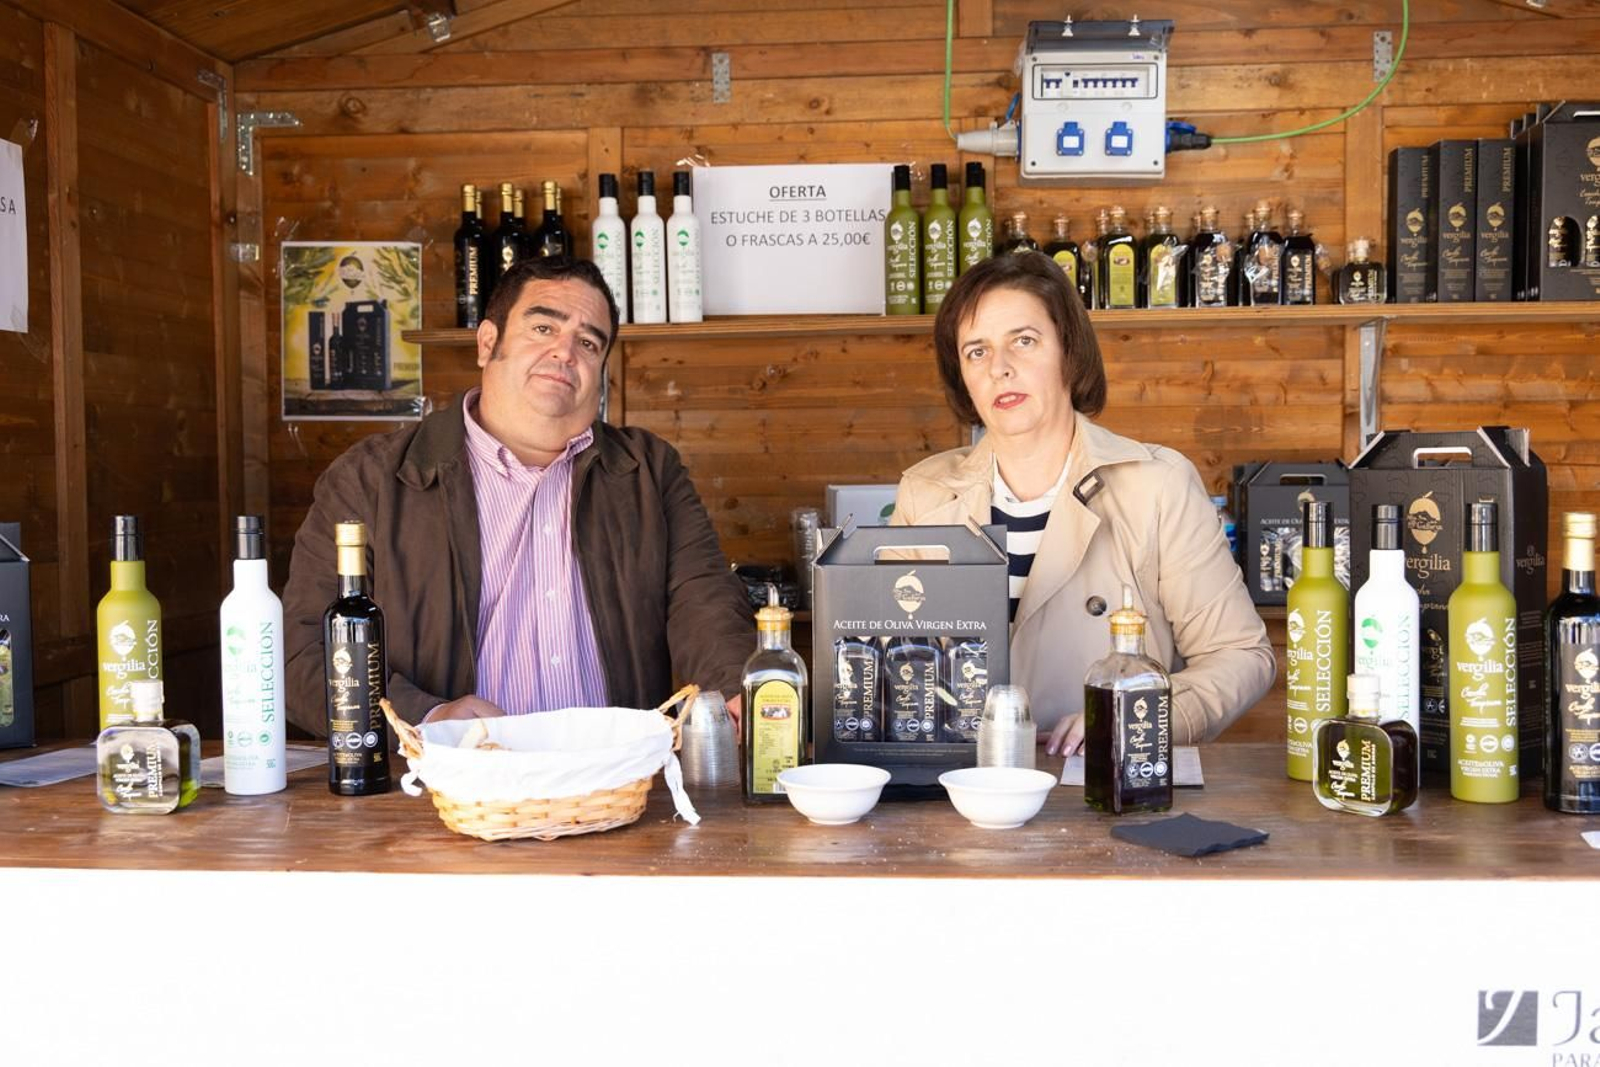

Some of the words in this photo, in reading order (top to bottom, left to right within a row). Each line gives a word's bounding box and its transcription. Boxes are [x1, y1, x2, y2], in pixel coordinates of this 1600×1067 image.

[711, 210, 774, 224] ESTUCHE
[779, 210, 797, 224] DE
[803, 210, 811, 223] 3
[815, 208, 886, 222] BOTELLAS
[769, 185, 827, 199] OFERTA
[726, 235, 737, 247] O
[741, 233, 804, 247] FRASCAS
[808, 233, 818, 246] A
[822, 232, 871, 248] 25,00€
[1406, 553, 1451, 579] ergilia
[145, 619, 158, 679] CCIÓN
[833, 619, 867, 630] ACEITE
[869, 620, 882, 630] DE
[884, 619, 914, 630] OLIVA
[915, 619, 954, 630] VIRGEN
[956, 619, 987, 630] EXTRA
[102, 659, 146, 679] vergilia
[367, 643, 382, 729] PREMIUM
[863, 658, 874, 718] PREMIUM
[1315, 610, 1332, 712] SELECCIÓN
[1456, 660, 1504, 681] vergilia
[1503, 617, 1517, 727] SELECCIÓN
[925, 662, 934, 719] PREMIUM
[1158, 695, 1169, 762] PREMIUM
[1361, 740, 1372, 801] PREMIUM
